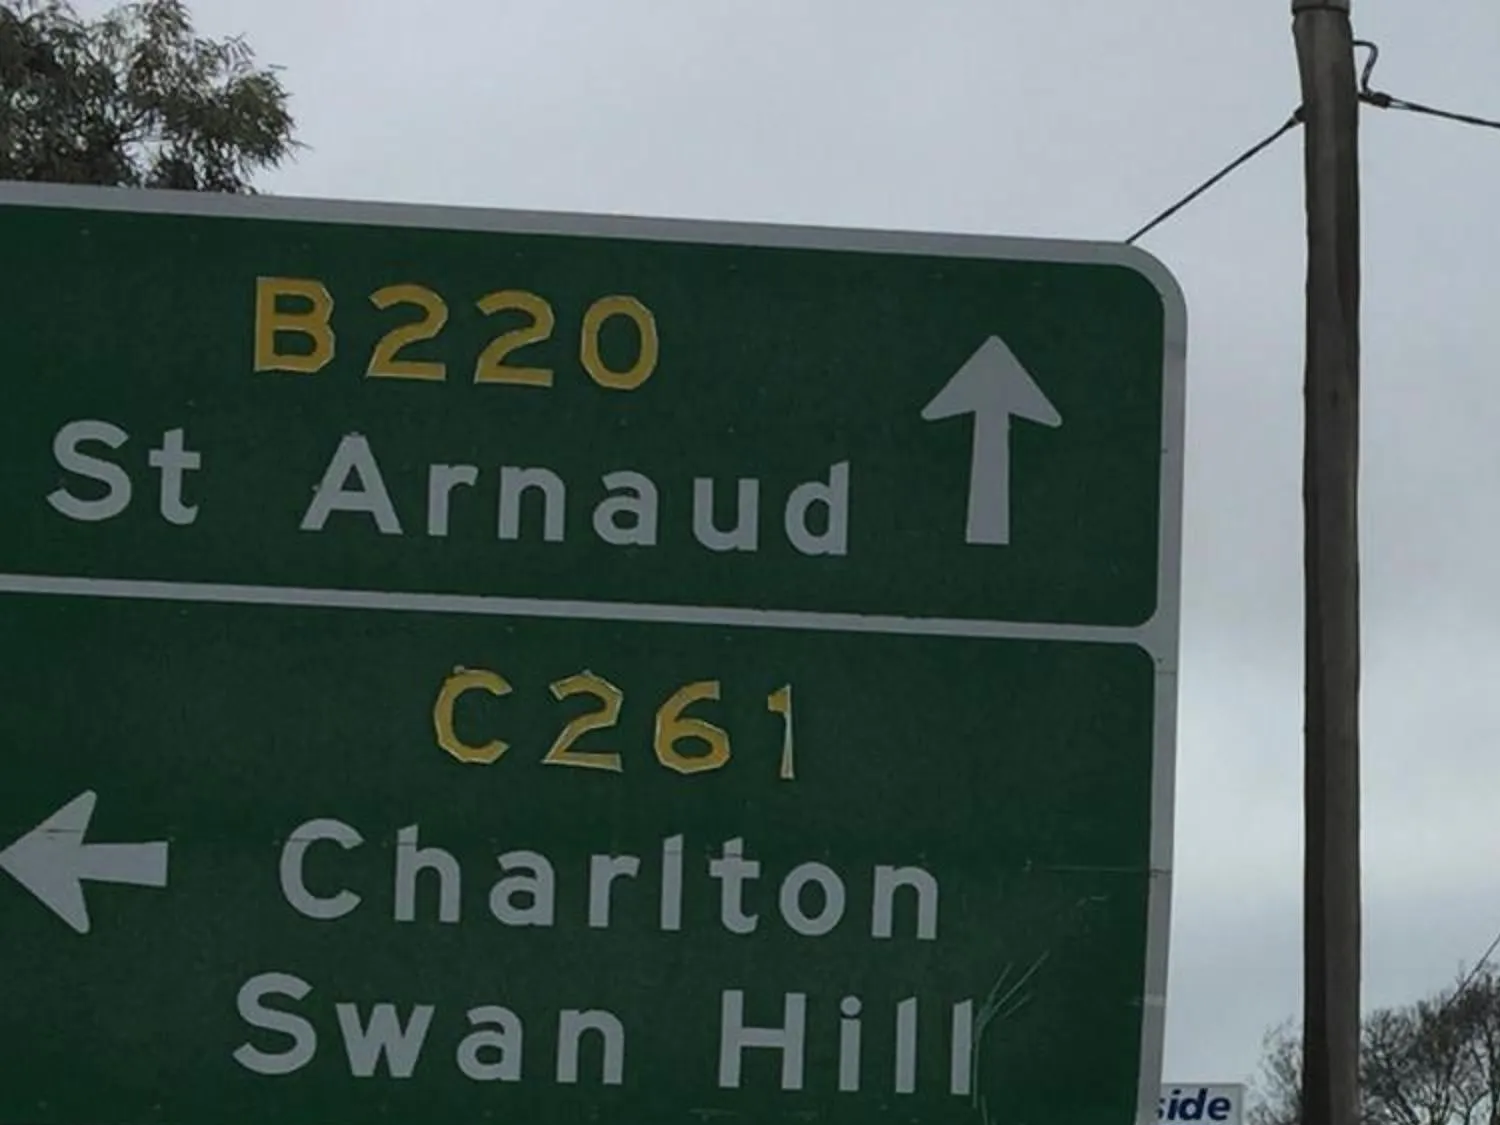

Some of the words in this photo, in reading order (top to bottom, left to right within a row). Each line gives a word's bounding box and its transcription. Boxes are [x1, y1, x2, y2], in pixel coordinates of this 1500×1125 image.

[254, 276, 660, 391] B220
[46, 418, 201, 526] St
[299, 430, 851, 557] Arnaud
[432, 664, 796, 782] C261
[278, 817, 940, 941] Charlton
[232, 970, 626, 1086] Swan
[718, 989, 974, 1097] Hill
